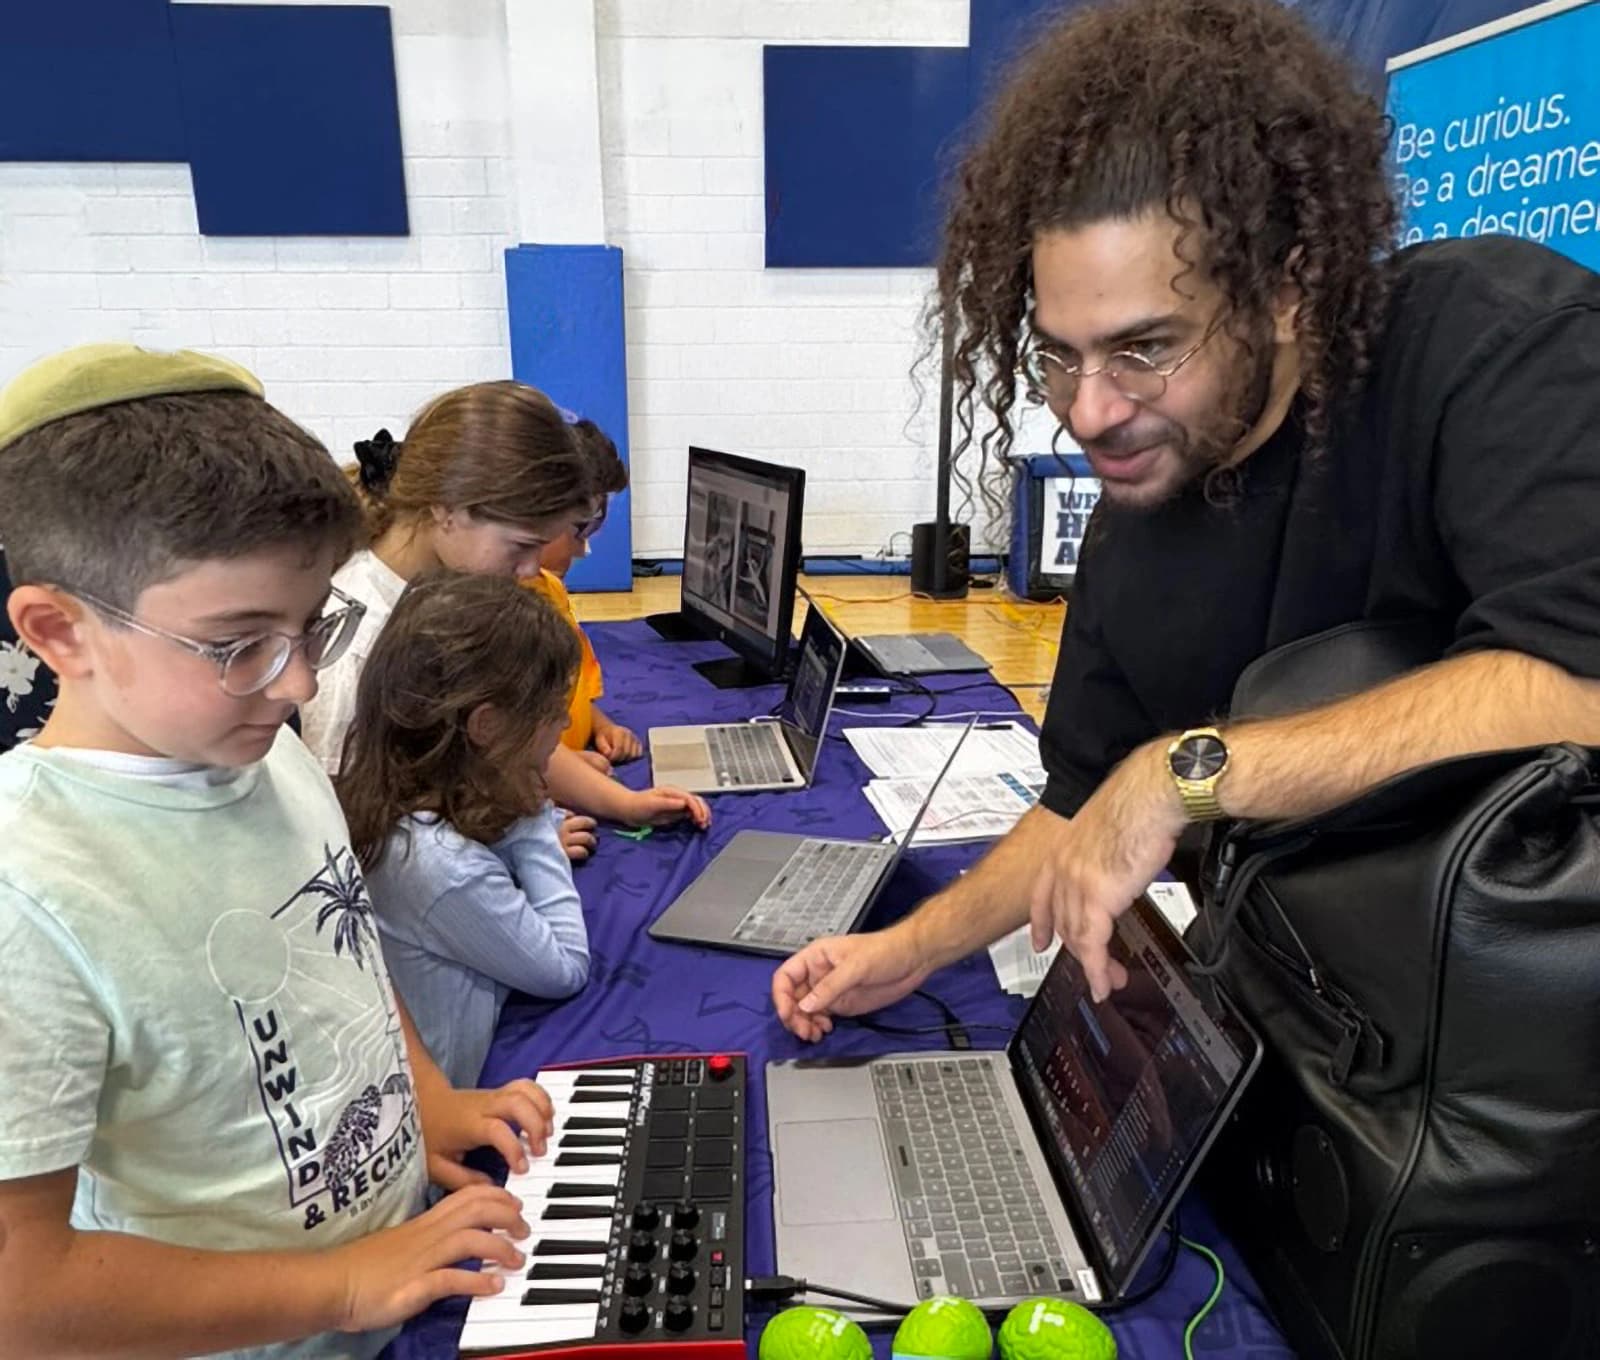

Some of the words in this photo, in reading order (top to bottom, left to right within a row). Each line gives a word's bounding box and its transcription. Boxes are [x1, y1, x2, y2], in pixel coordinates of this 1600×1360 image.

[1396, 123, 1436, 164] Be
[1443, 93, 1571, 153] curious.
[1436, 171, 1455, 203] a
[252, 1009, 321, 1188] UNWIND
[303, 1202, 327, 1231] &
[331, 1111, 416, 1214] RECHA
